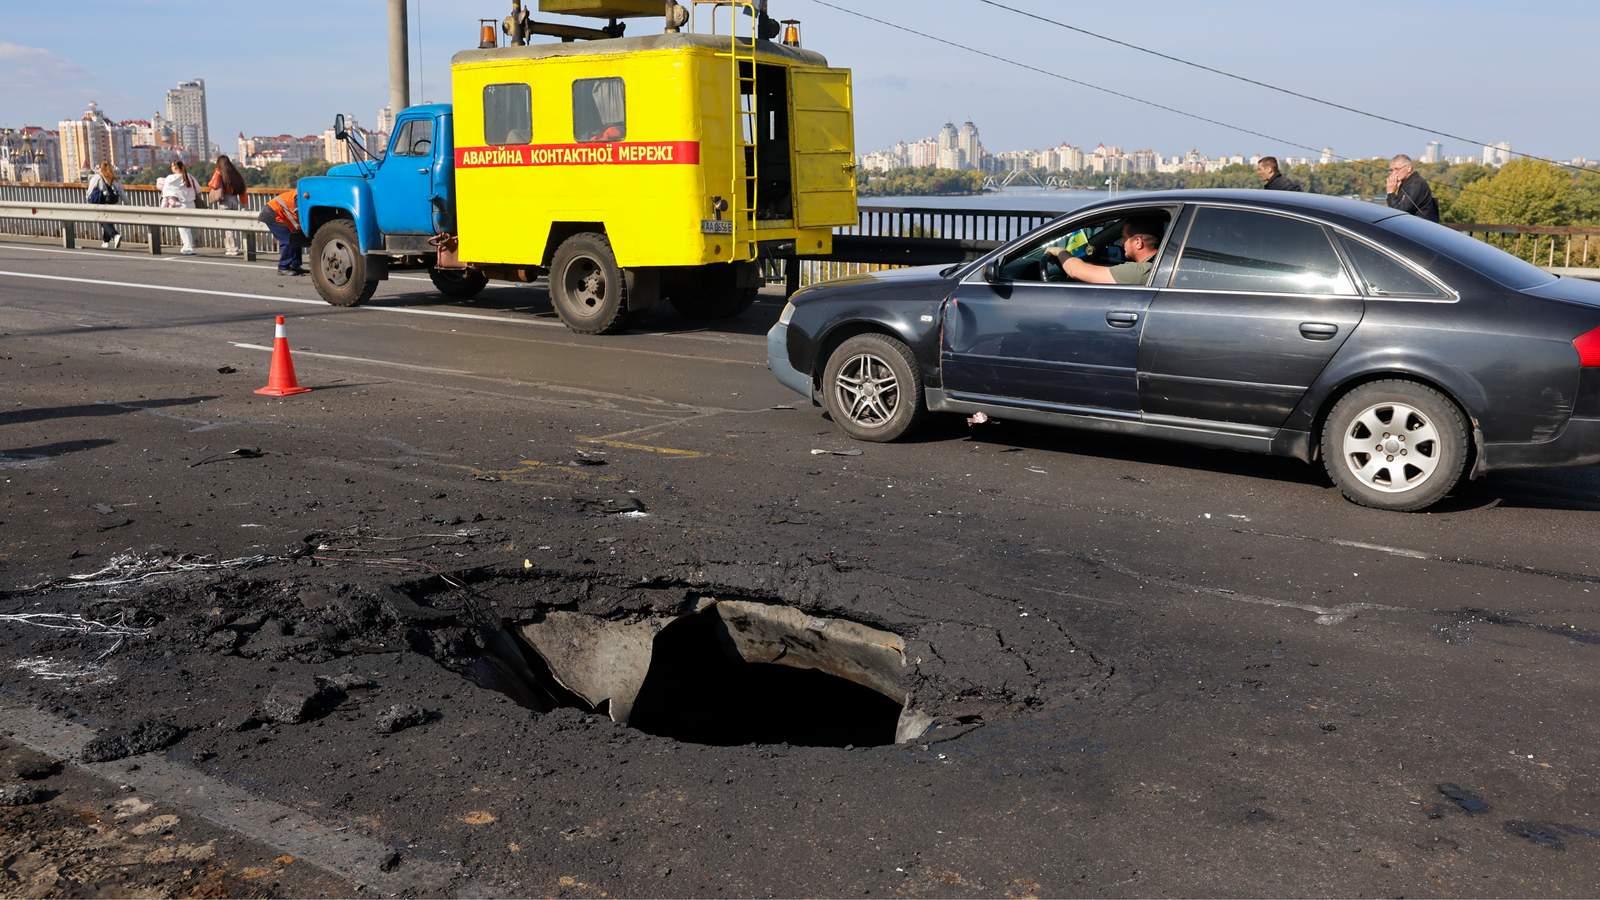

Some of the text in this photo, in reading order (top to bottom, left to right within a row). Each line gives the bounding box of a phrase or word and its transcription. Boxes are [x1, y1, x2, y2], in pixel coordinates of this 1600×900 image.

[463, 144, 673, 165] АВАРІЙНА КОНТАКТНОЇ МЕРЕЖІ
